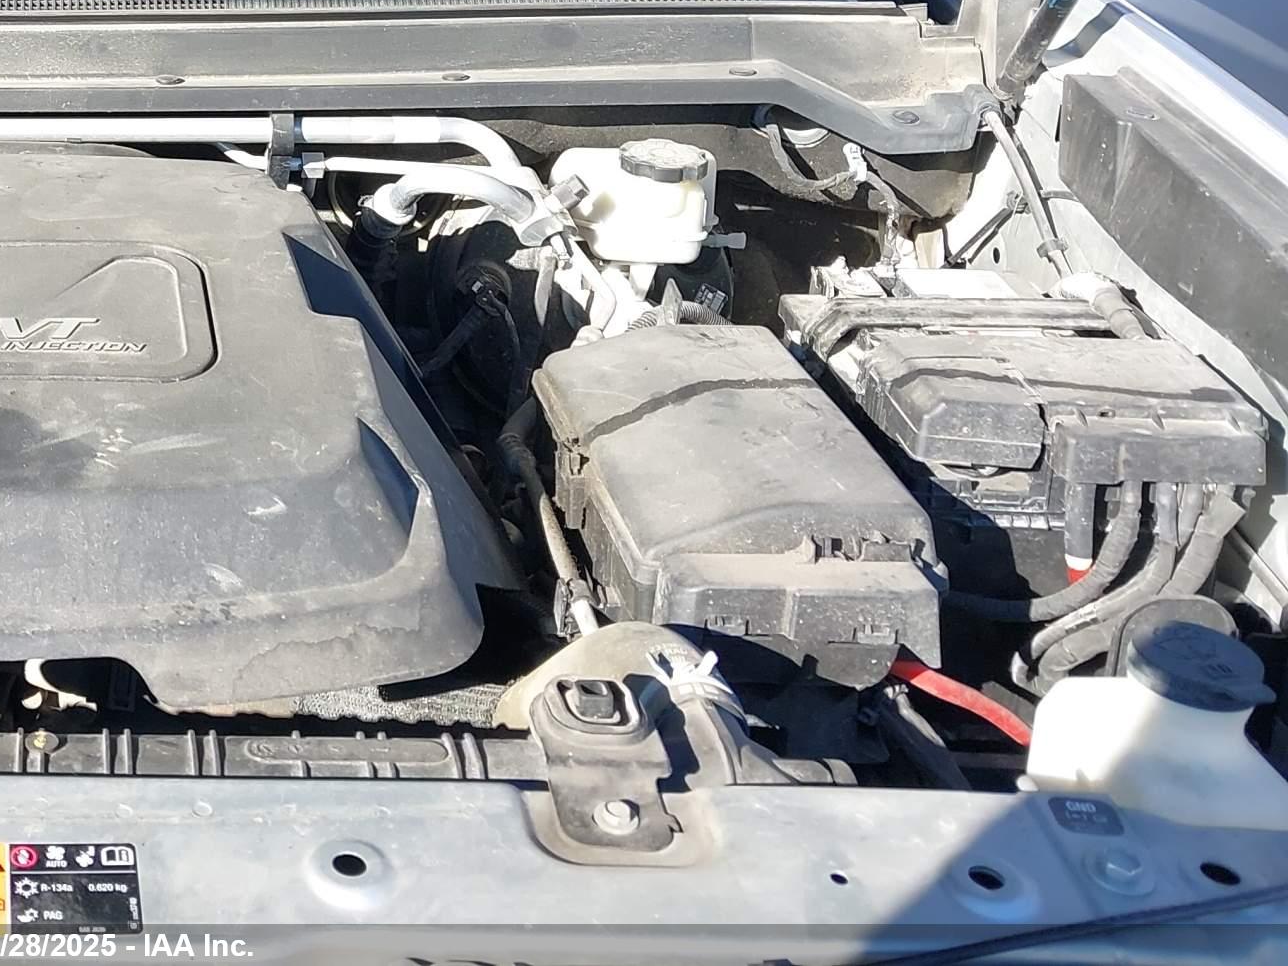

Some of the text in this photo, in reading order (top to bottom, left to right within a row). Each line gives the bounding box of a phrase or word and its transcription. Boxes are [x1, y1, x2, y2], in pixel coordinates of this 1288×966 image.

[0, 340, 148, 353] INJECTION
[1065, 800, 1097, 813] GND
[46, 860, 68, 868] AUTO
[40, 883, 73, 892] R-134a
[115, 883, 128, 893] kg
[43, 910, 64, 921] PAG
